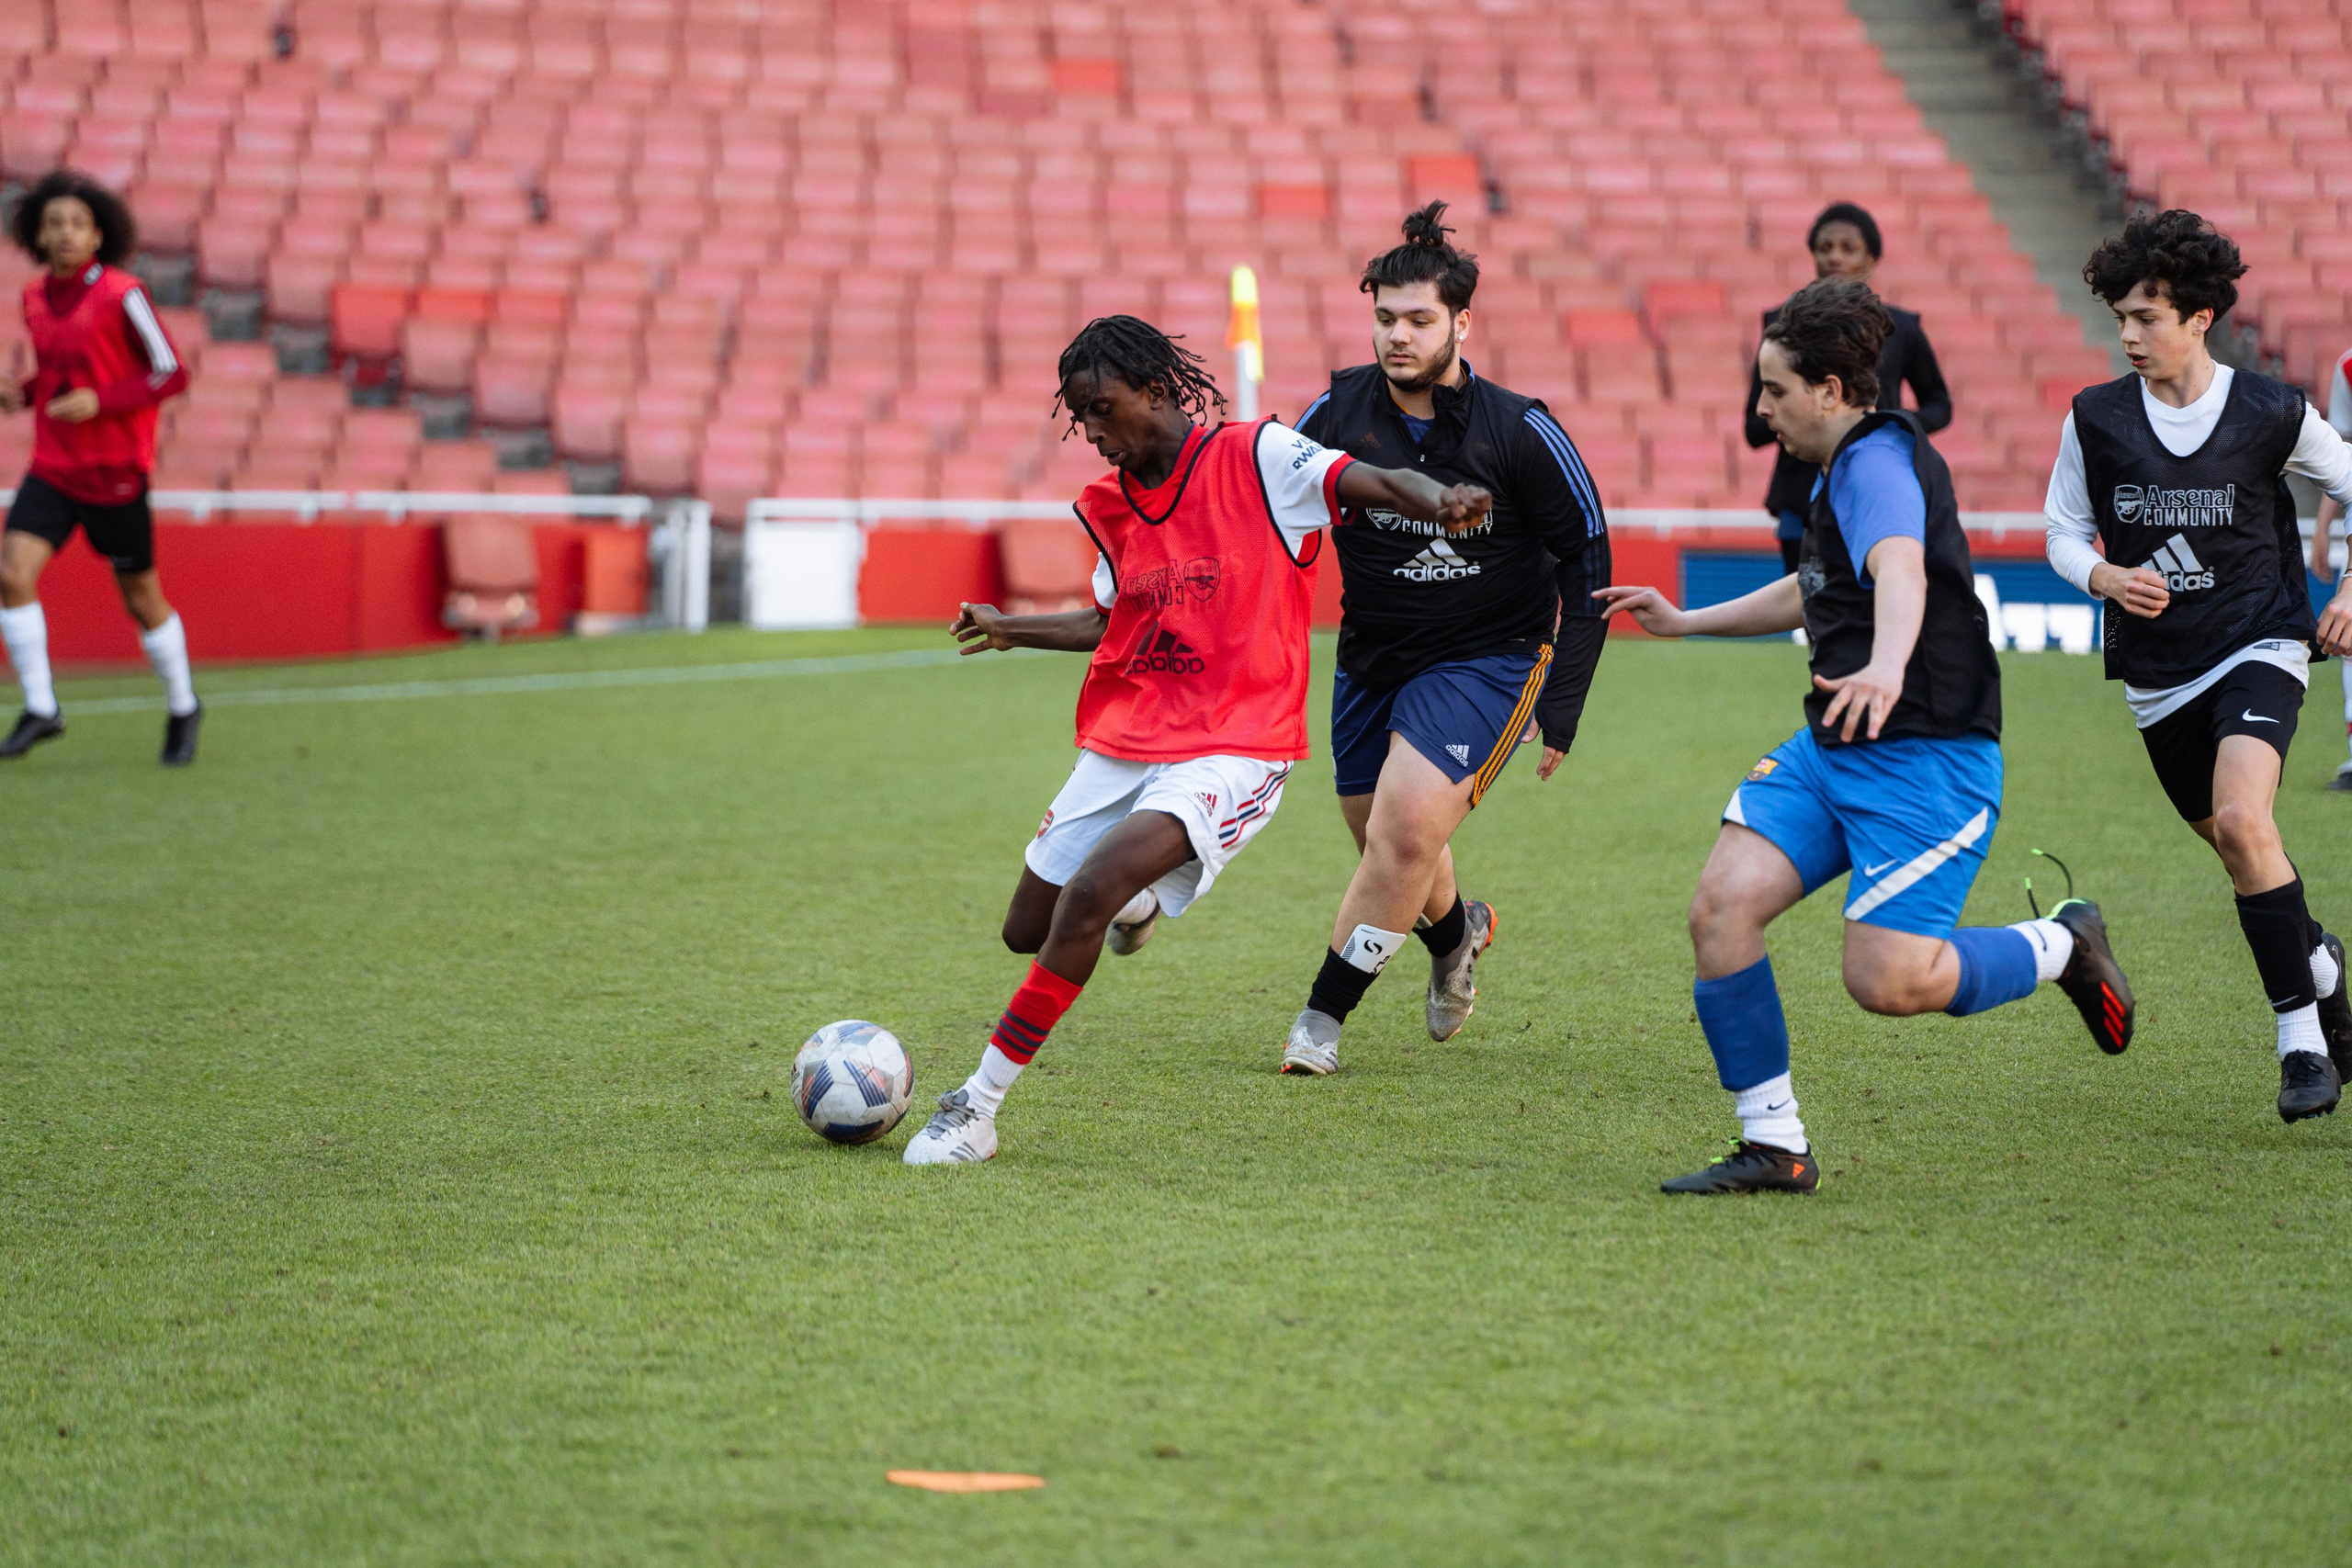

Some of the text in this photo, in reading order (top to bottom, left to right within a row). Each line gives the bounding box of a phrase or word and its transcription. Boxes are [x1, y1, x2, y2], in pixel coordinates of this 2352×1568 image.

[2144, 484, 2235, 508] Arsenal
[2143, 507, 2233, 526] COMMUNITY
[1393, 563, 1481, 582] adidas
[2158, 570, 2215, 592] idas
[1445, 744, 1469, 767] adidas
